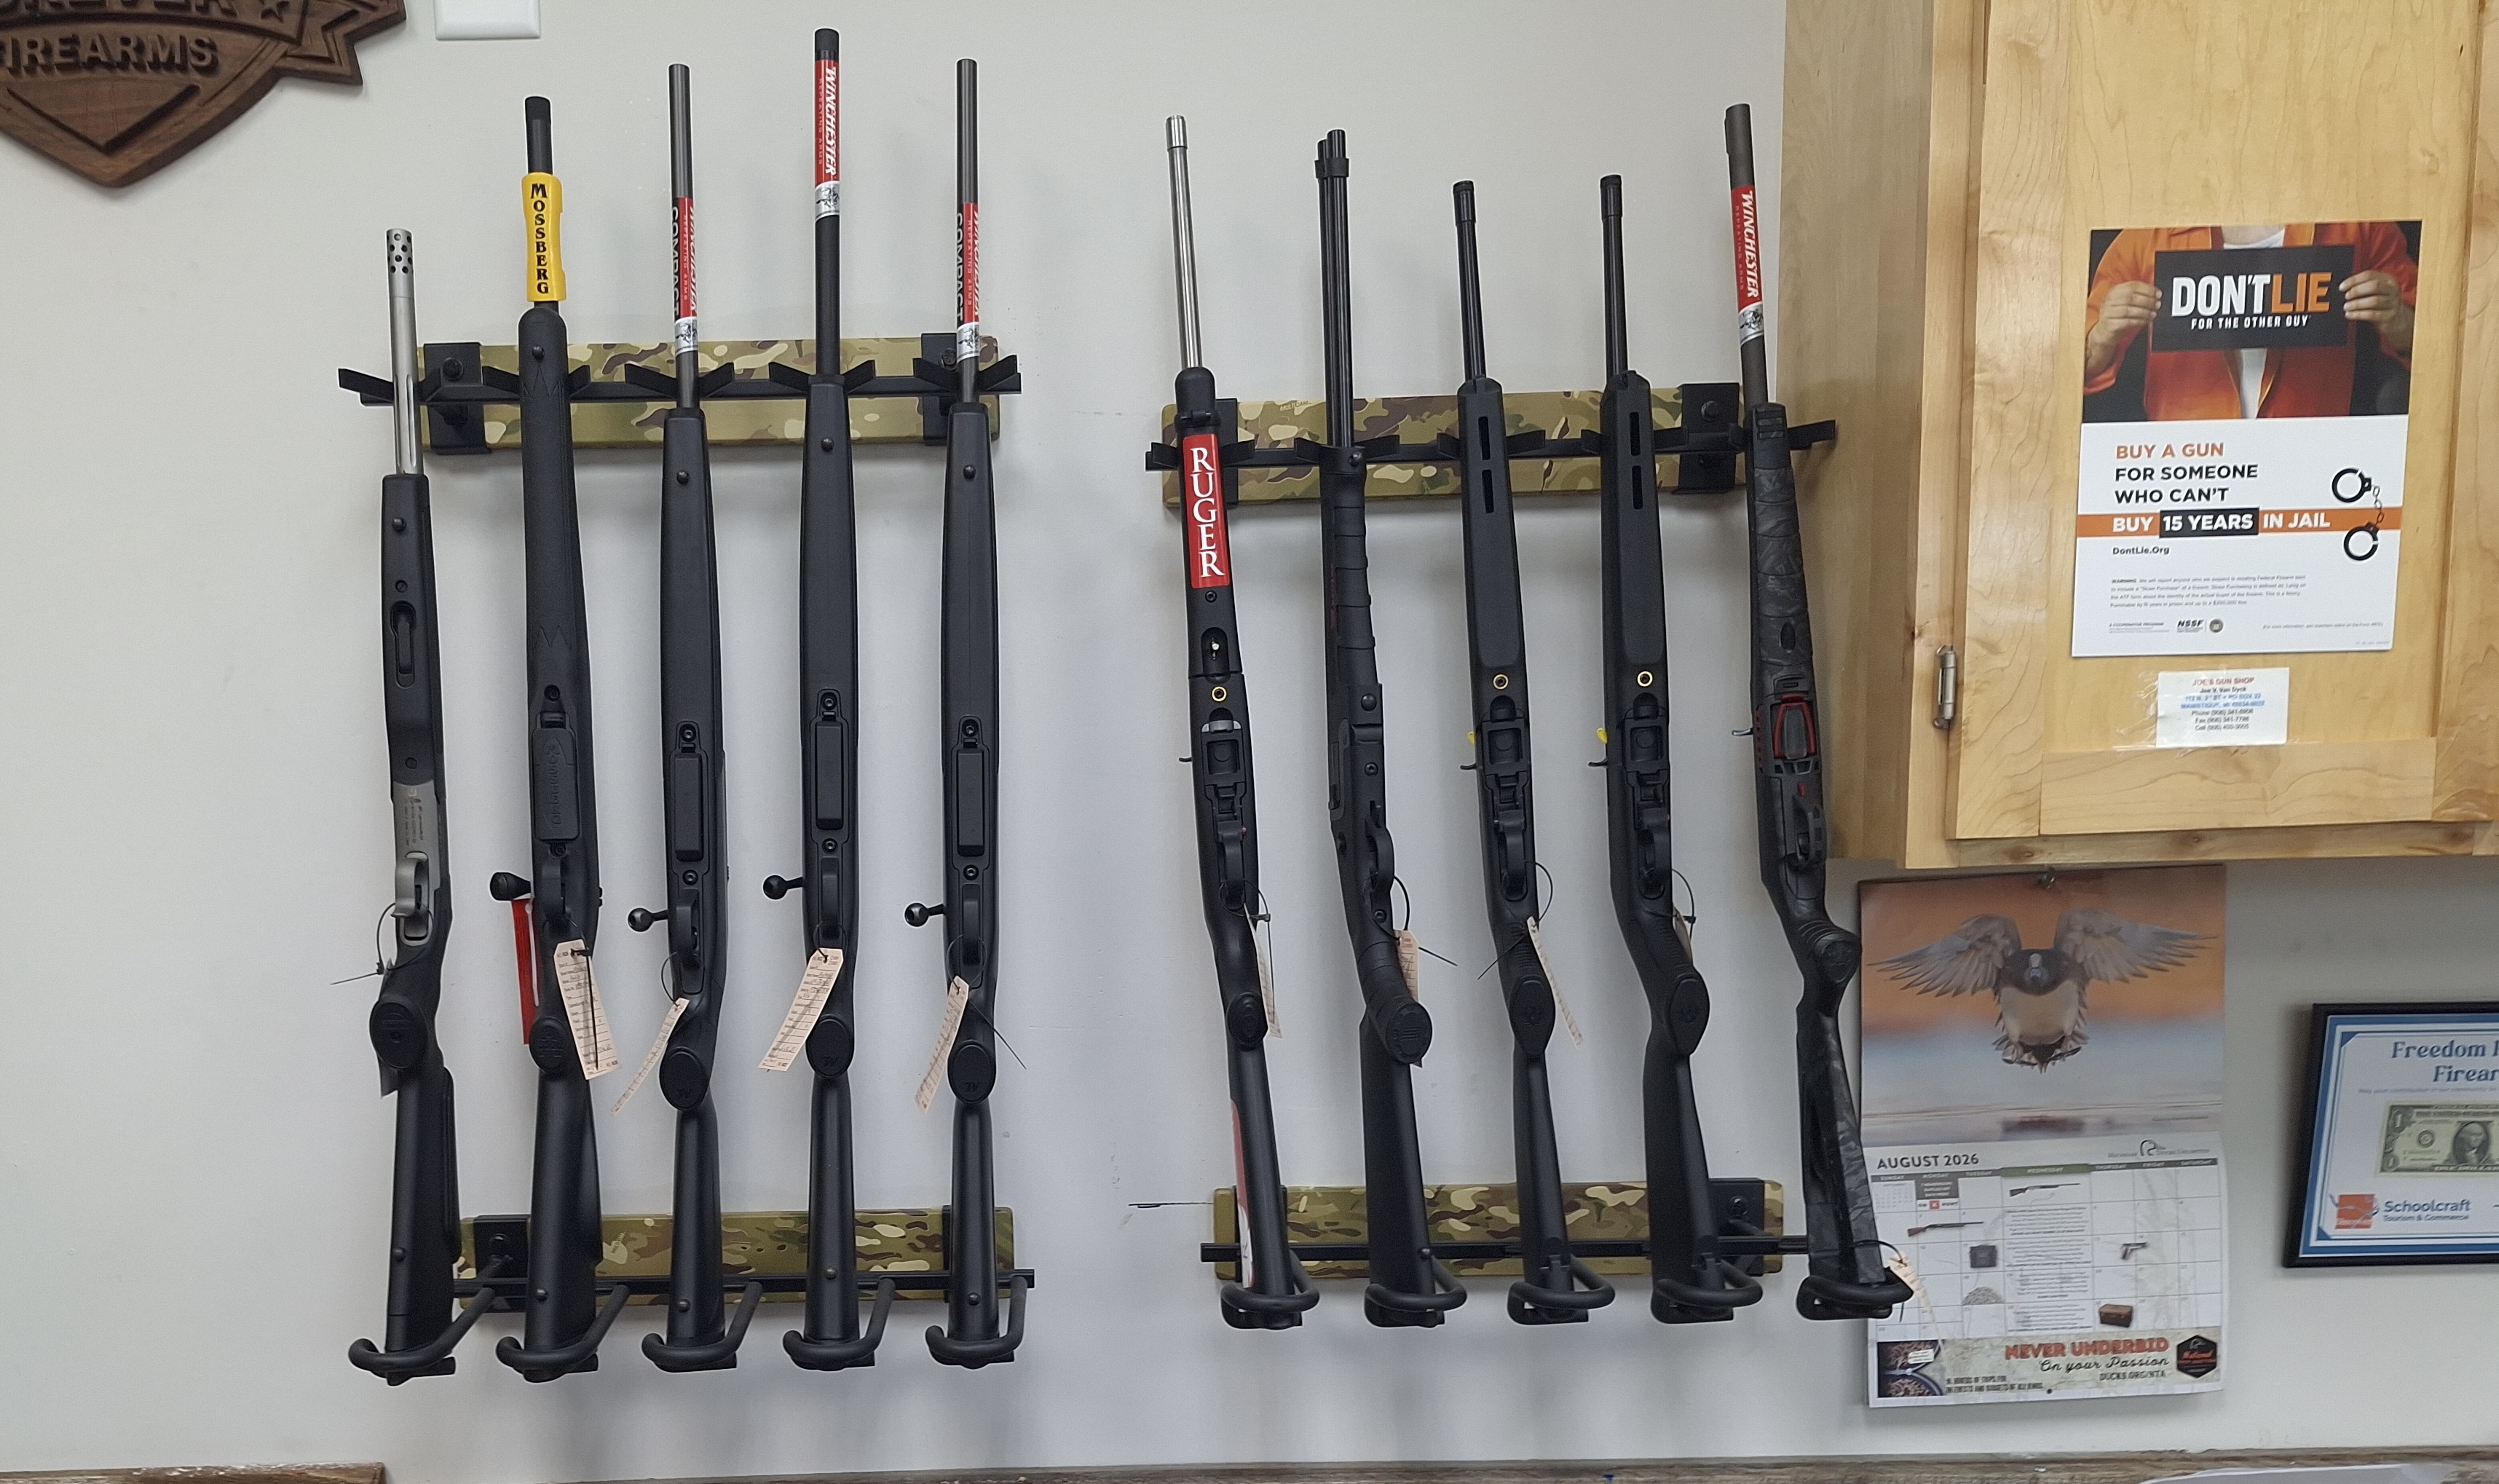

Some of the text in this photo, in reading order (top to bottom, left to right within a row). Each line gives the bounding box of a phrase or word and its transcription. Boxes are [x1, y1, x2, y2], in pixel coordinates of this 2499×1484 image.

[825, 67, 837, 175] WINCHESTER
[530, 183, 549, 294] MOSSBERG
[1742, 190, 1759, 299] WINCHESTER
[2191, 315, 2309, 331] FOR THE OTHER GUY
[2116, 443, 2224, 459] BUY A GUN
[2115, 464, 2258, 482] FOR SOMEONE
[2115, 487, 2230, 504] WHO CAN'T
[1190, 447, 1225, 578] RUGER
[2112, 512, 2331, 532] BUY 15 YEARS IN JAIL
[2112, 546, 2170, 556] DontLie.Org
[2177, 620, 2204, 628] NSSF
[2391, 1039, 2486, 1059] Freedom
[1877, 1153, 1979, 1169] AUGUST 2026
[2383, 1199, 2472, 1213] Schoolcraft
[2005, 1337, 2170, 1360] NEVER UNDERBID
[2065, 1360, 2102, 1374] your
[2106, 1355, 2169, 1369] Passion
